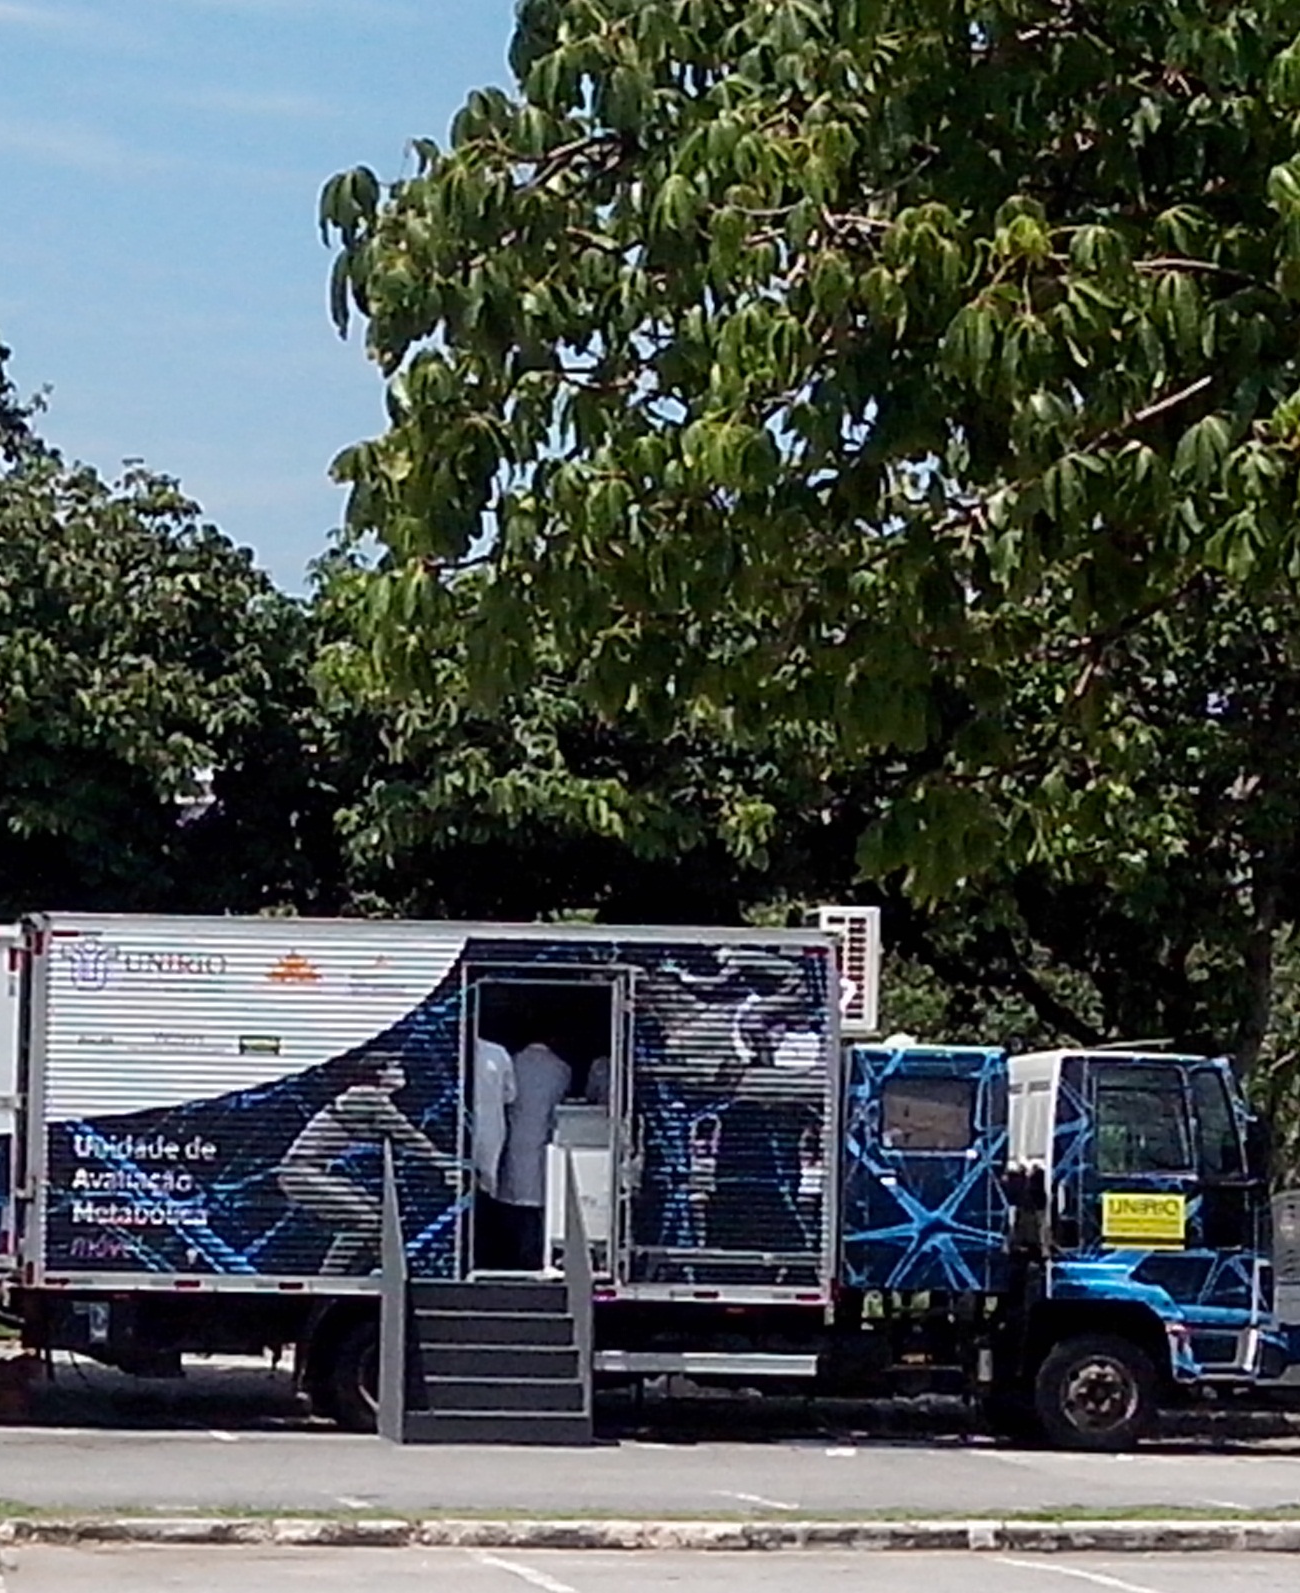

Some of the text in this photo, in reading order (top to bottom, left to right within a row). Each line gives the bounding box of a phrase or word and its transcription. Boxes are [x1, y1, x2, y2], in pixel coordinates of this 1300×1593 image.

[124, 953, 225, 974] UNIRIO
[73, 1134, 217, 1159] Unidade de
[1108, 1198, 1180, 1216] UNIRIO
